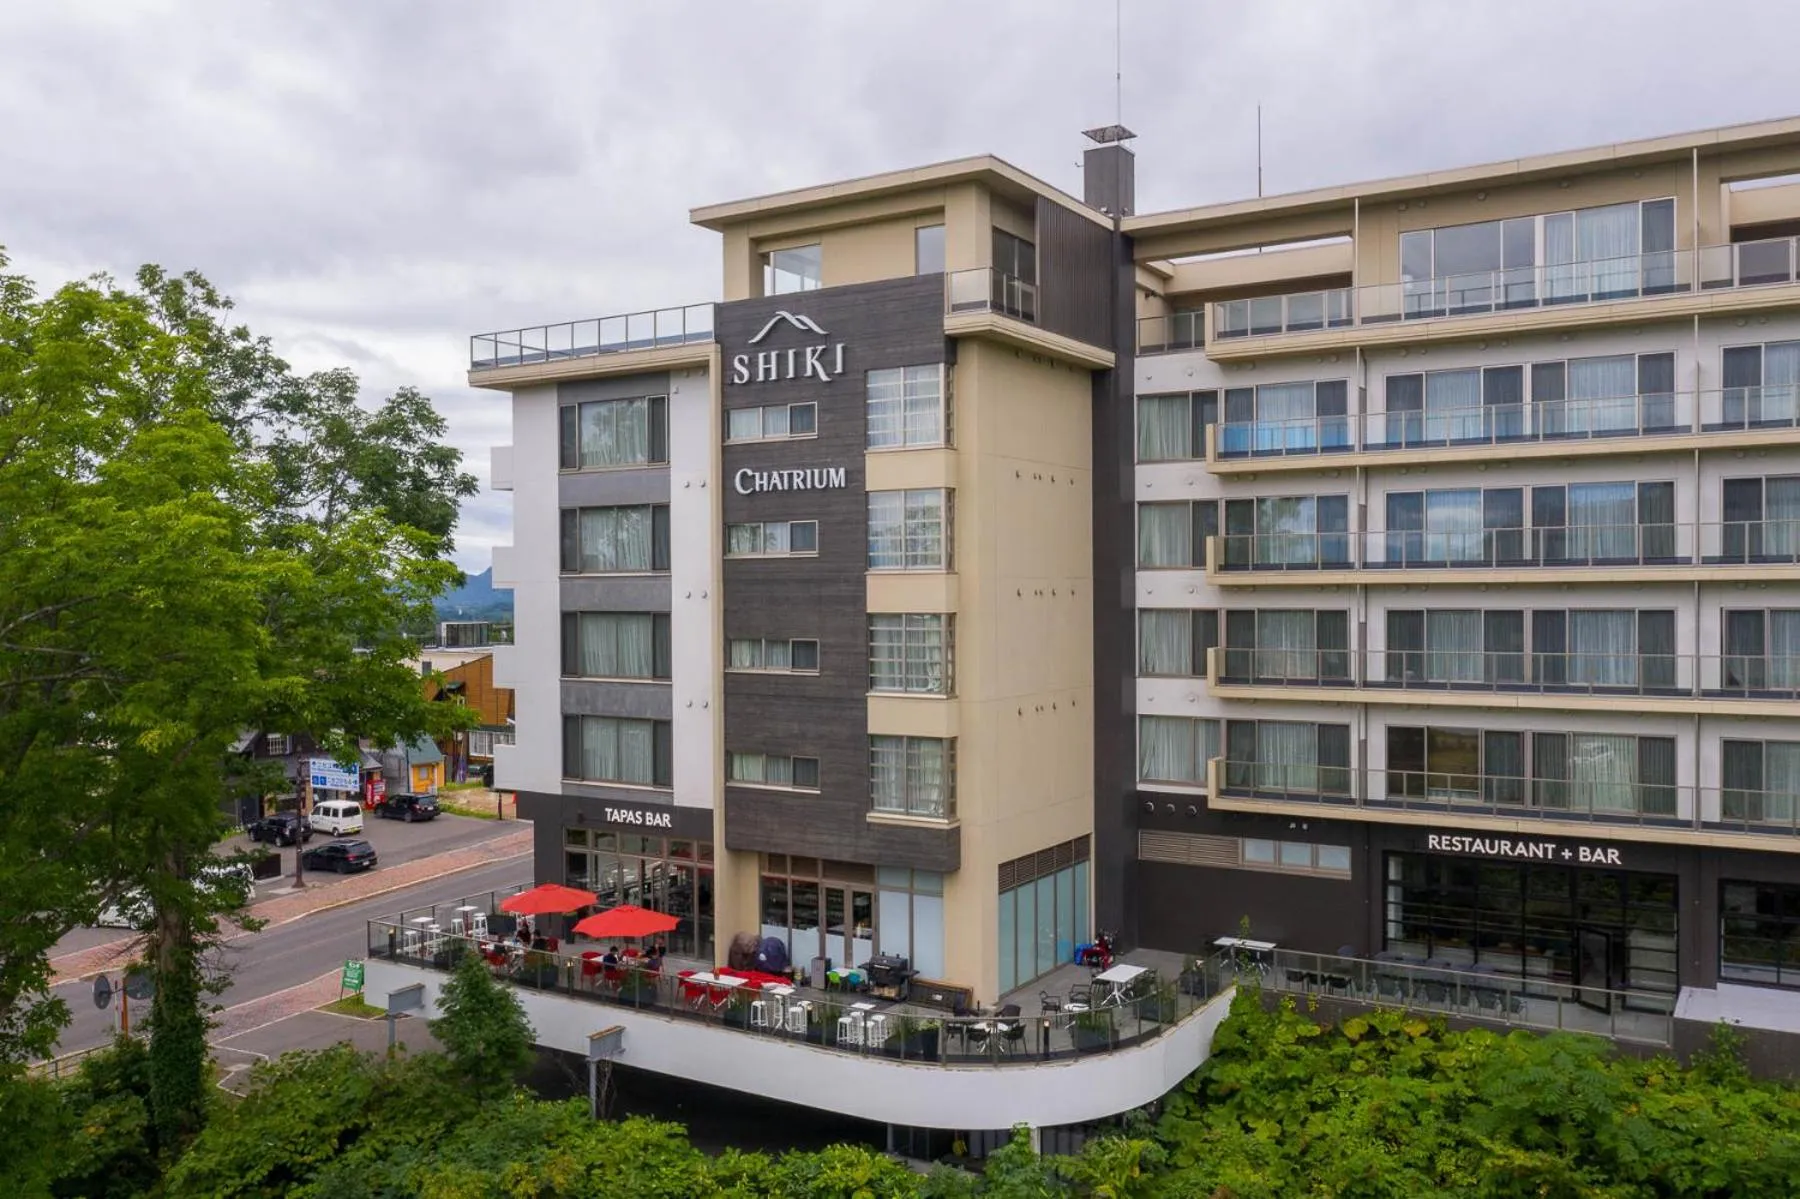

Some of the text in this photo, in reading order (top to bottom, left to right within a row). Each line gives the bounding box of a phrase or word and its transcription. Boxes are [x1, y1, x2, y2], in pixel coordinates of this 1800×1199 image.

[733, 343, 846, 384] SHIKI
[734, 467, 846, 495] CHATRIUM
[604, 807, 673, 828] TAPAS BAR
[1428, 834, 1557, 860] RESTAURANT
[1579, 846, 1622, 865] BAR
